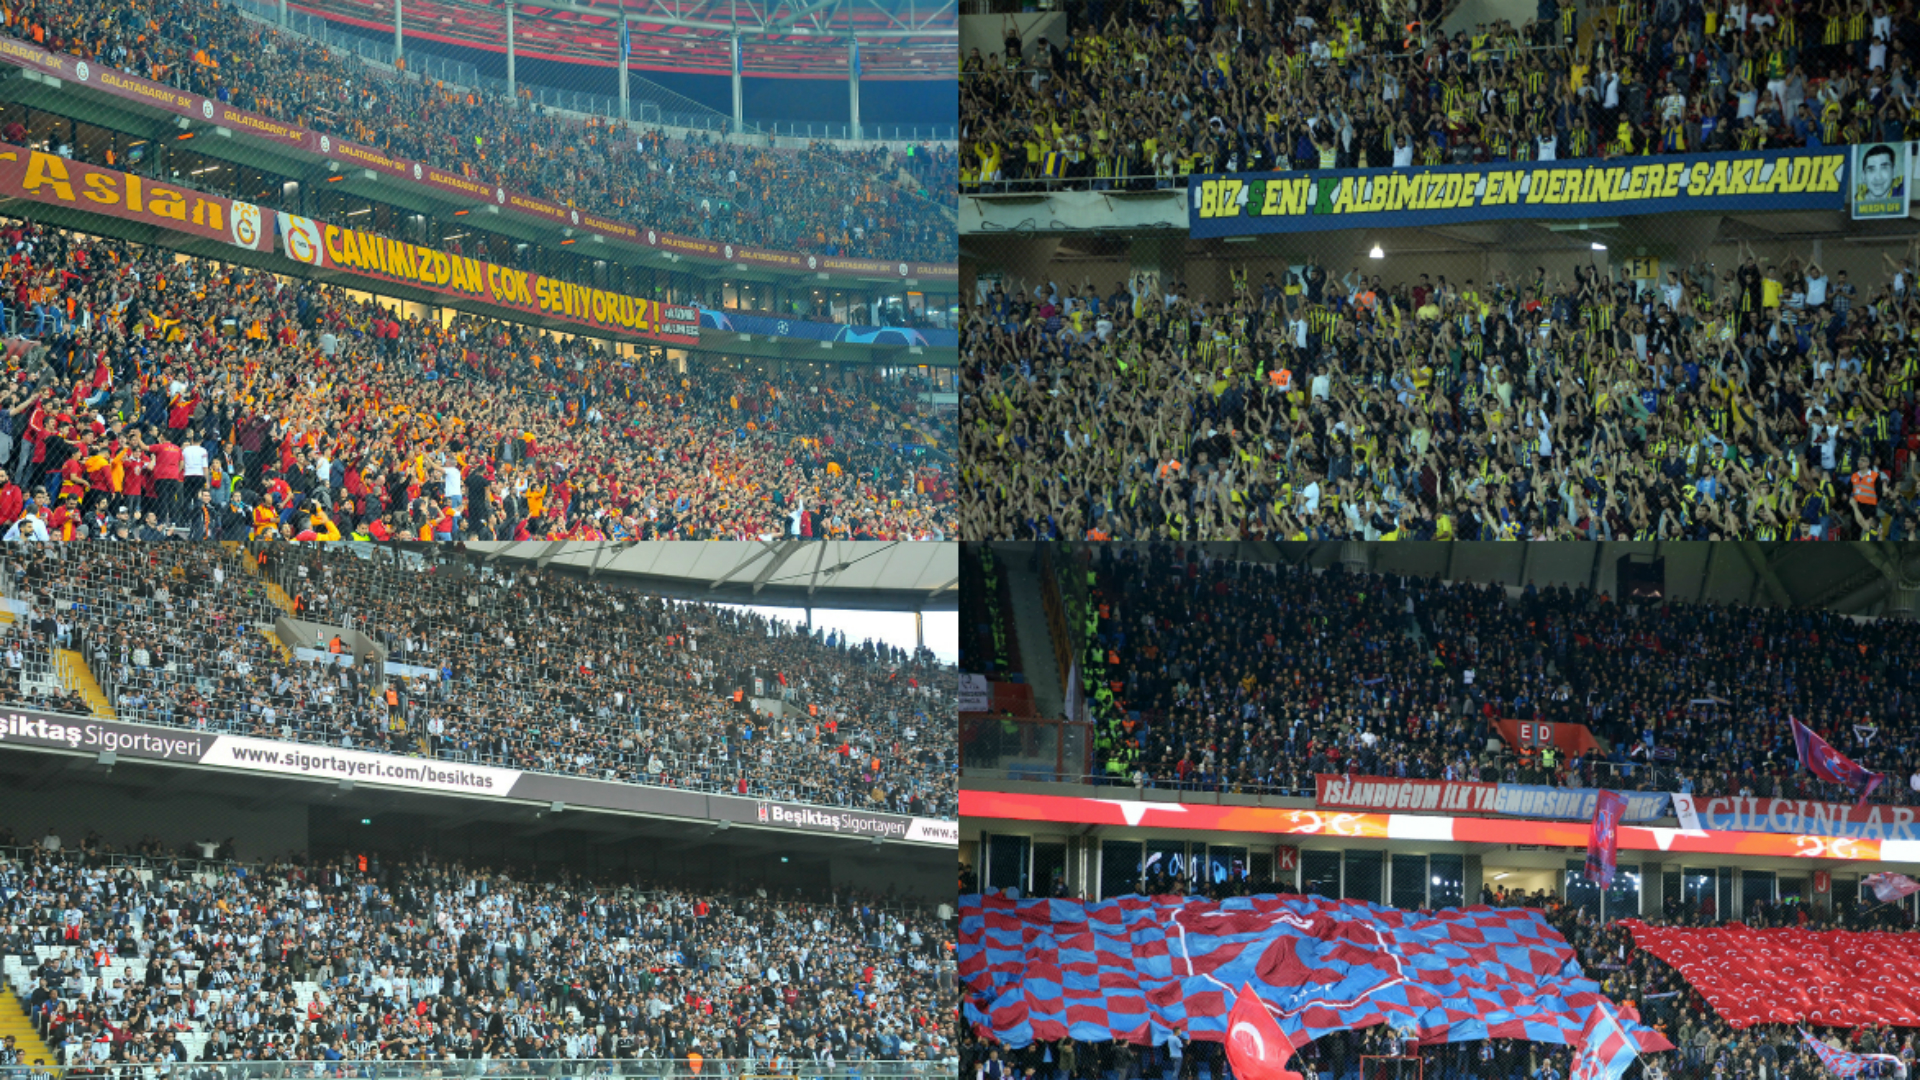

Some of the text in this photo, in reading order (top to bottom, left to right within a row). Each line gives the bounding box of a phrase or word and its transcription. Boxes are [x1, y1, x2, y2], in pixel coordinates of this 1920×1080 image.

[0, 41, 63, 70] SARAY SK
[101, 73, 192, 108] GALATASARAY SK
[224, 110, 288, 137] GALATASARAY
[0, 150, 223, 231] Aslan
[1200, 155, 1845, 218] BİZ SENİ KALBİMİZDE EN DERİNLERE SAKLADIK
[325, 224, 484, 294] CANIMIZDAN
[487, 263, 533, 306] ÇOK
[1633, 259, 1650, 276] F1
[85, 725, 201, 758] Sigortayeri
[1521, 724, 1530, 738] E
[1539, 725, 1550, 740] D
[232, 744, 494, 789] www.sigortayeri.com/besiktas
[772, 805, 906, 835] Beşiktaş Sigortayeri
[1282, 851, 1293, 869] K
[1818, 875, 1828, 892] J
